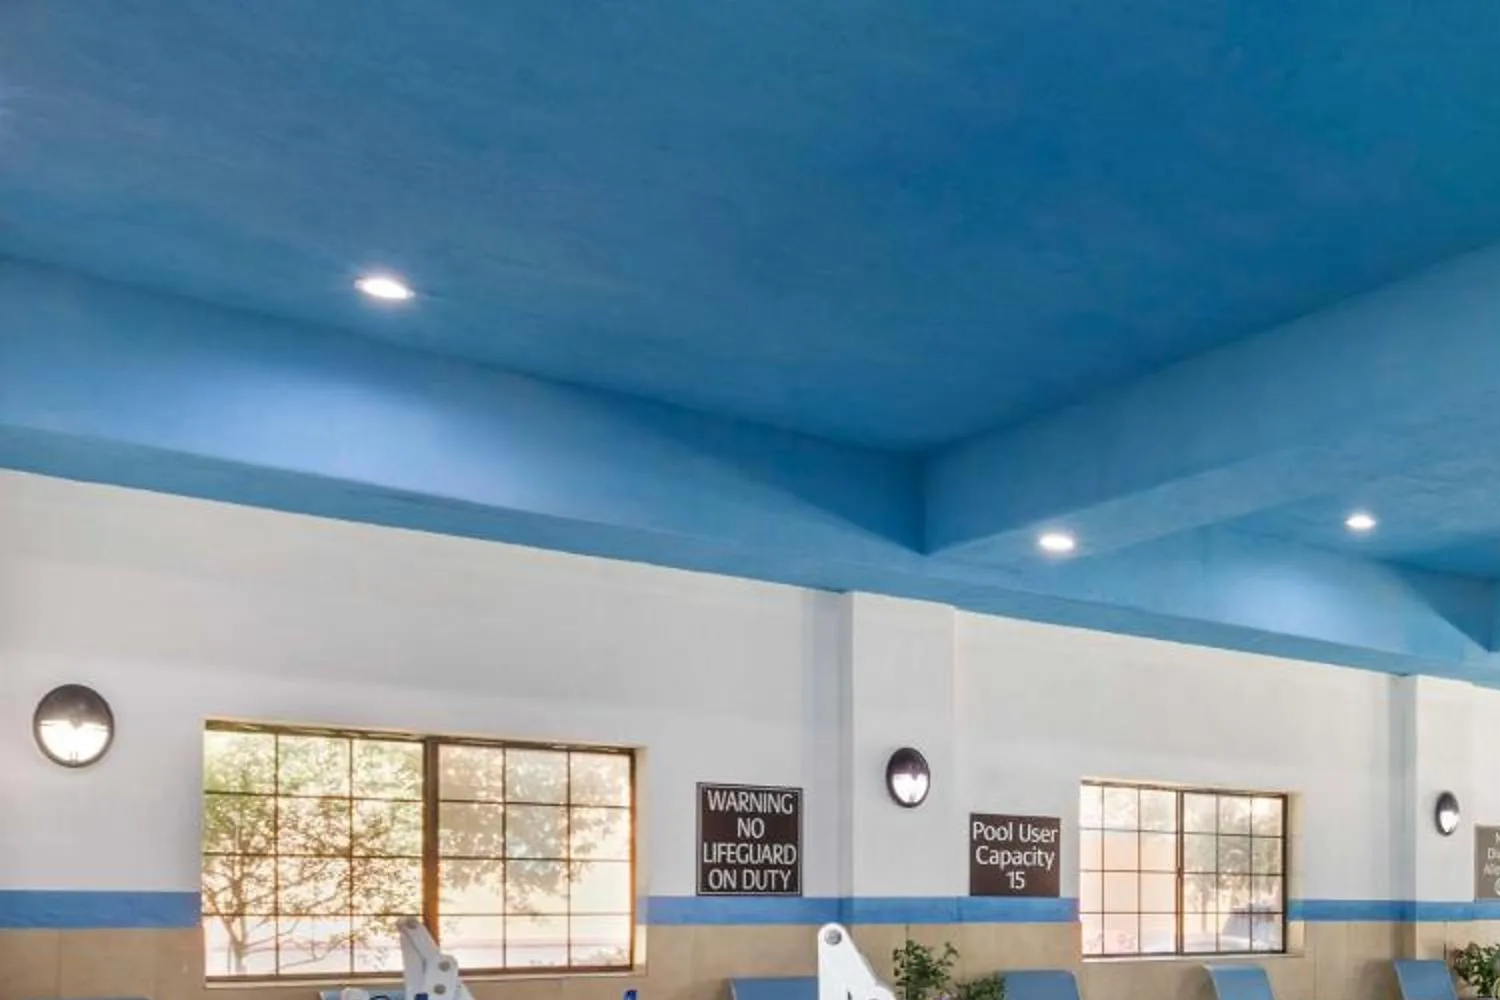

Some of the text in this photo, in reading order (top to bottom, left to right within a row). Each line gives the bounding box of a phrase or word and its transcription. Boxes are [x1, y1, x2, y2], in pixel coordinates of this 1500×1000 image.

[707, 789, 793, 815] WARNING
[737, 816, 765, 839] NO
[973, 820, 1058, 843] Pool User
[703, 842, 797, 865] LIFEGUARD
[975, 844, 1055, 871] Capacity
[708, 868, 791, 891] ON DUTY
[1005, 870, 1025, 890] 15
